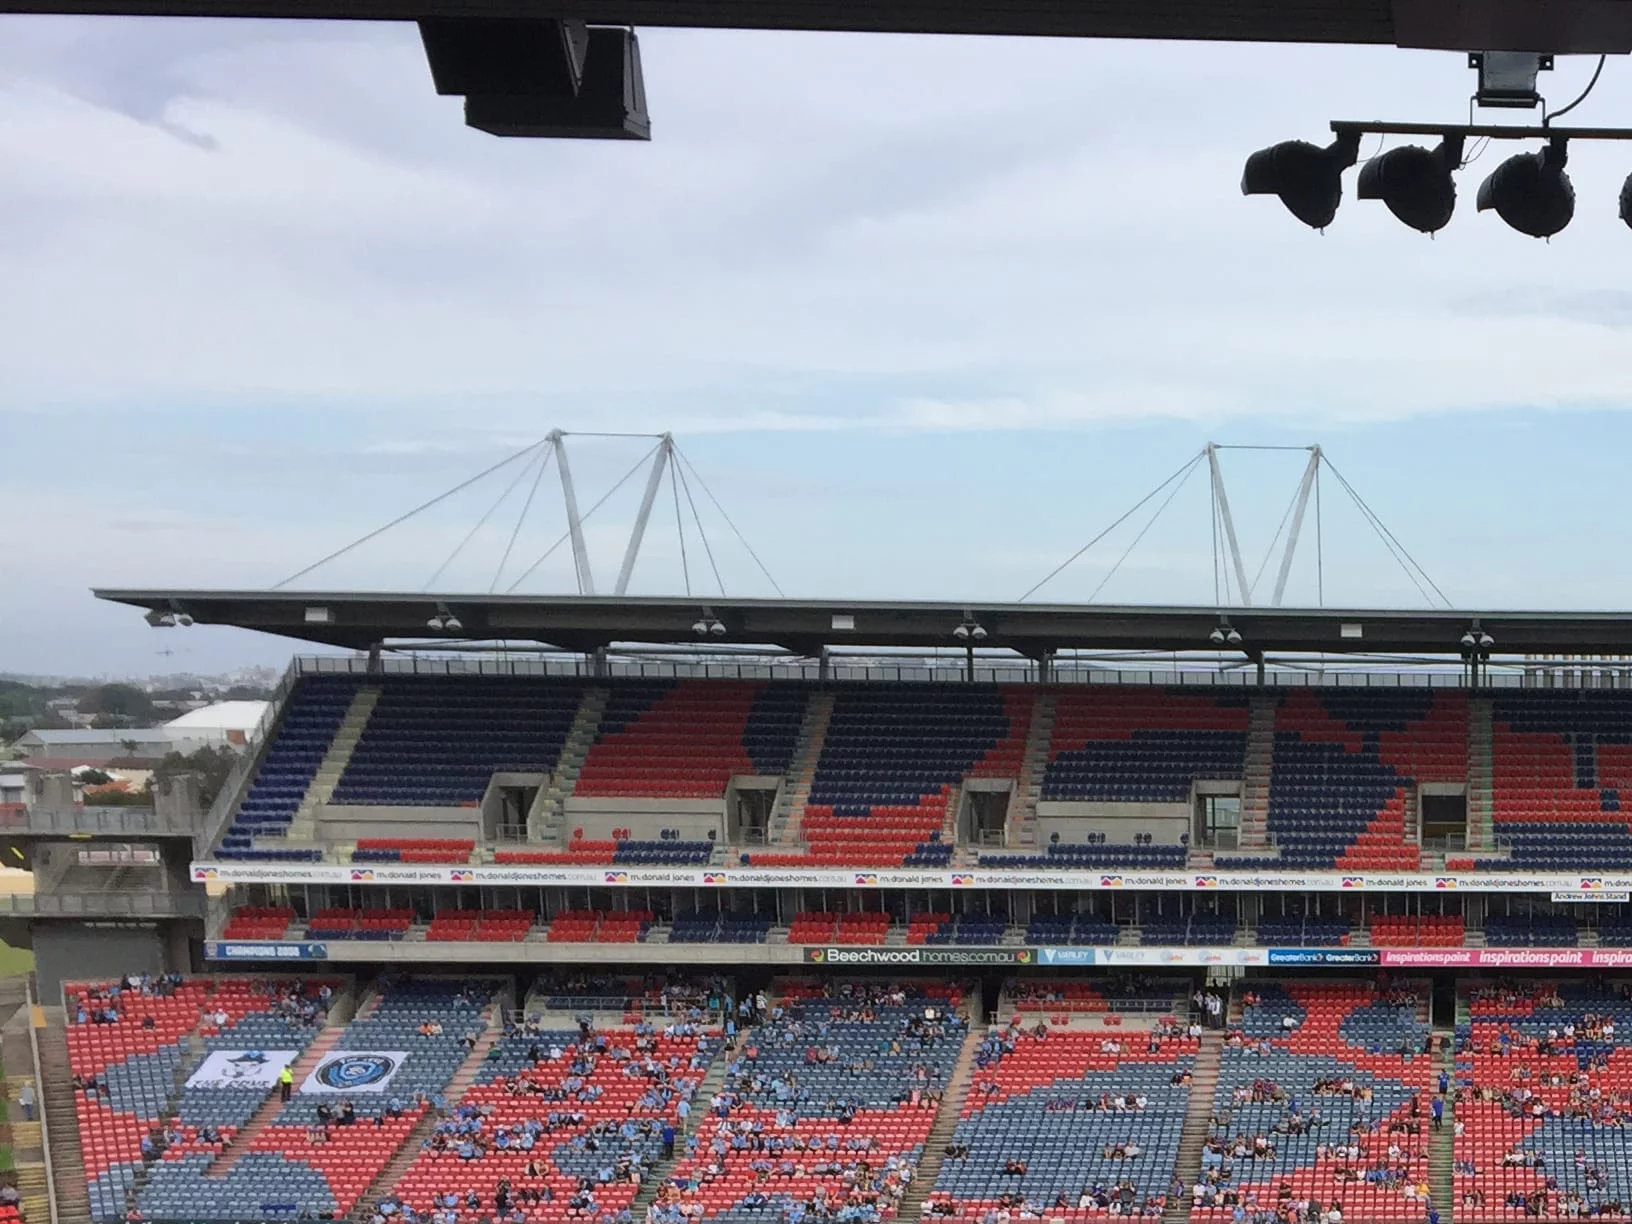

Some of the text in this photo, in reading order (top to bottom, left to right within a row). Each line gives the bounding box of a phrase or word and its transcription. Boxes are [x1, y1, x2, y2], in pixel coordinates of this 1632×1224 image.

[1406, 879, 1428, 888] jones
[827, 949, 920, 962] Beechwood
[1270, 953, 1318, 962] GreaterBank
[1326, 953, 1374, 962] GreaterBank
